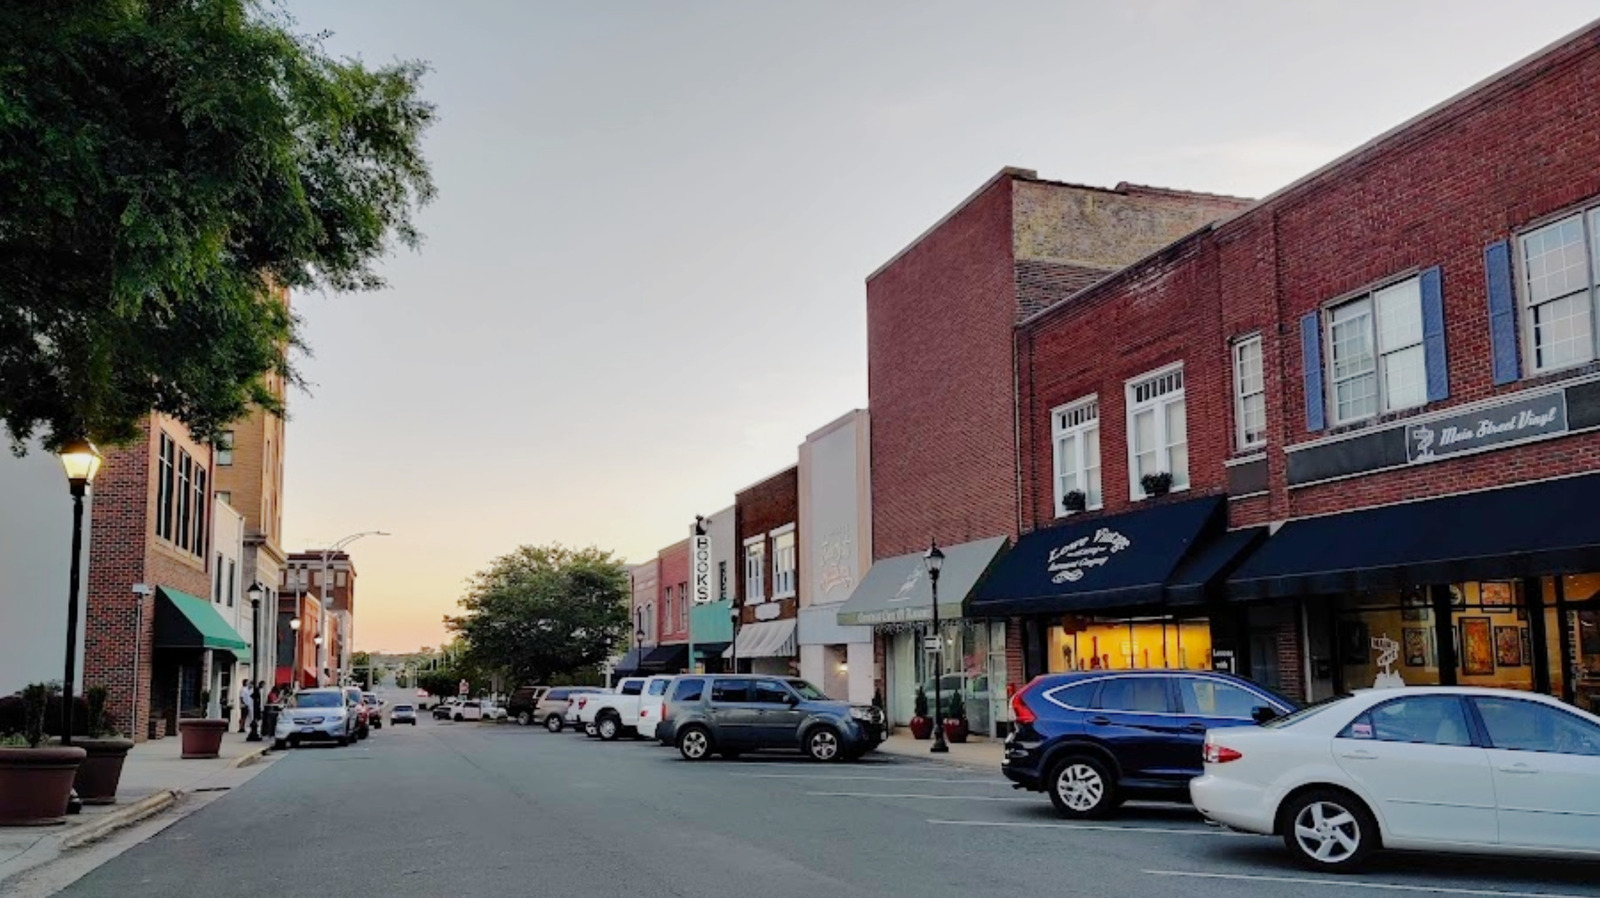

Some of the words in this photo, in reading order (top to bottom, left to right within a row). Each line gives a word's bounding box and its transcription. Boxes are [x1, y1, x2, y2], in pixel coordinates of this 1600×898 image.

[1439, 426, 1474, 446] Main
[1476, 416, 1517, 438] Street
[1518, 406, 1557, 430] Vinyl
[696, 537, 709, 600] BOOKS
